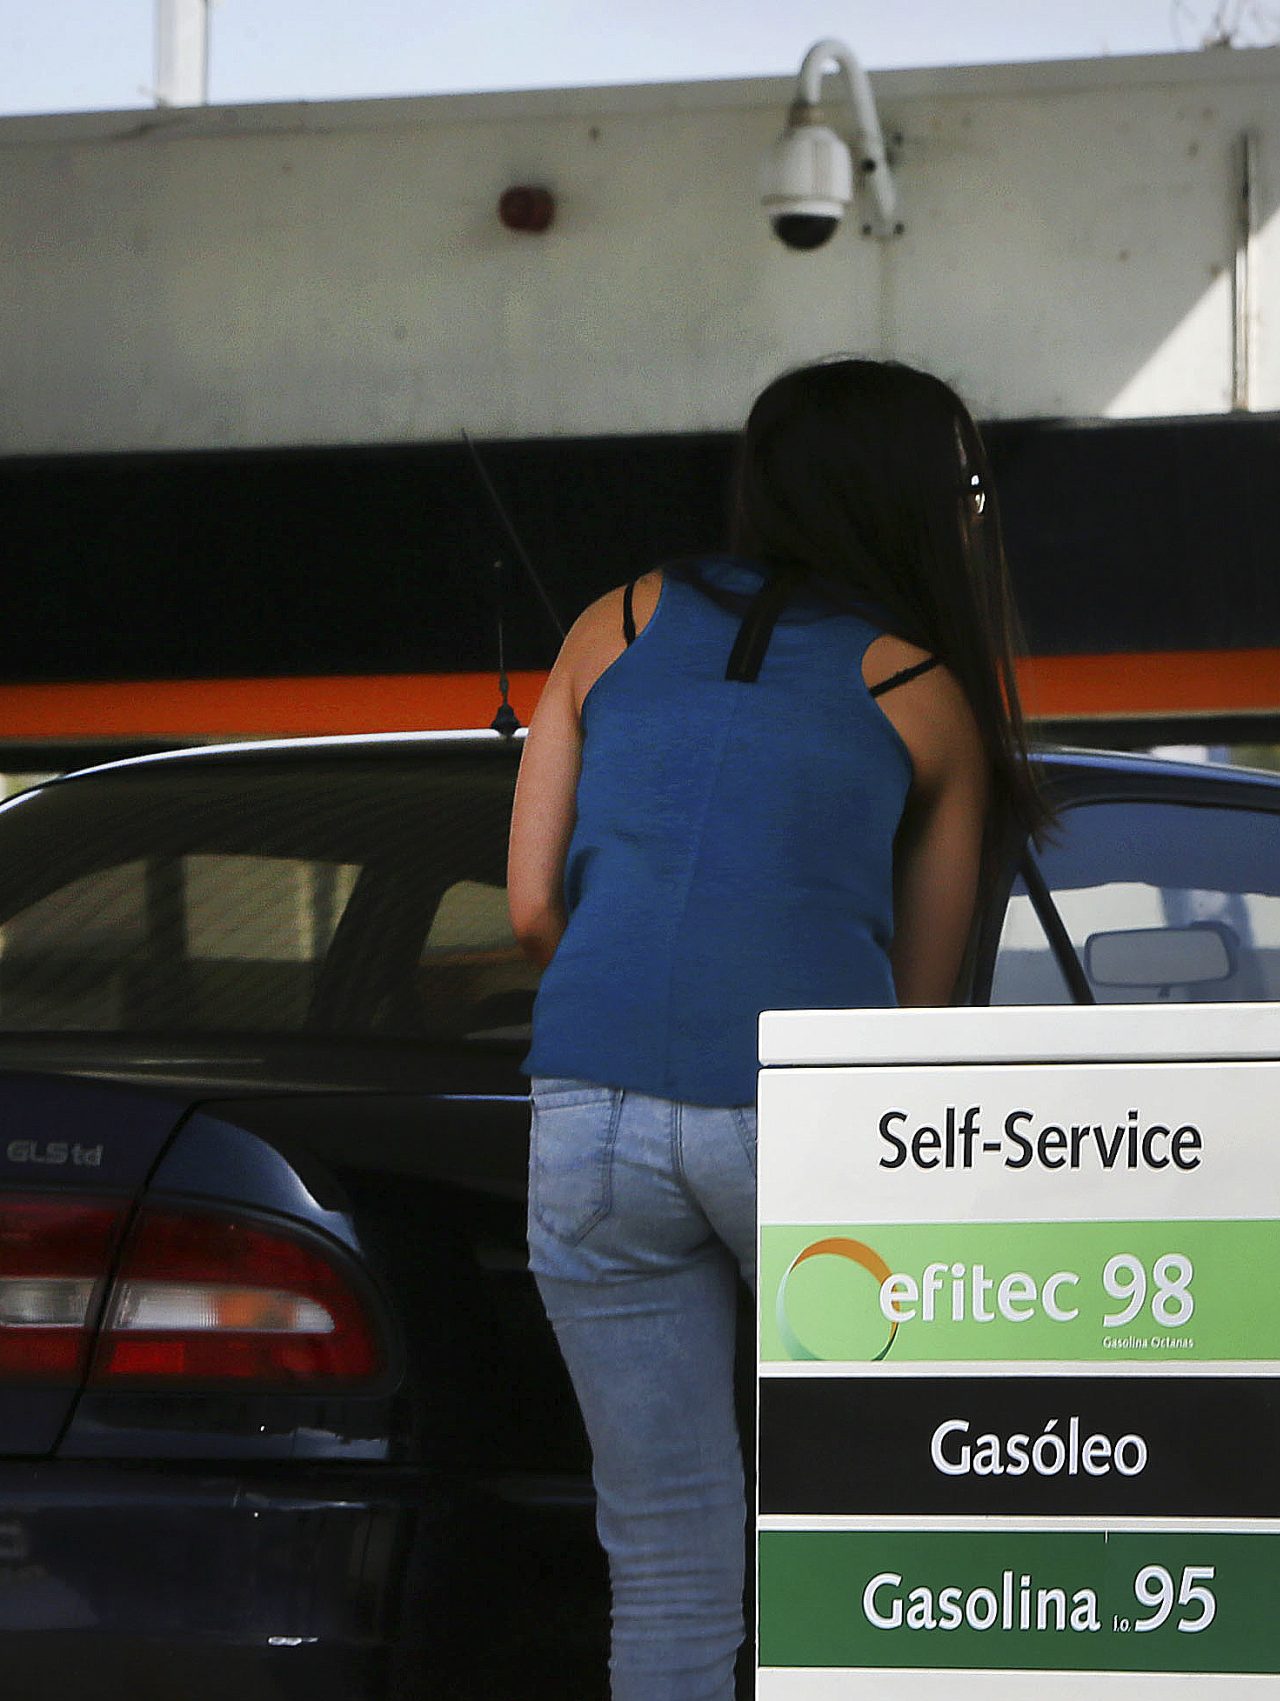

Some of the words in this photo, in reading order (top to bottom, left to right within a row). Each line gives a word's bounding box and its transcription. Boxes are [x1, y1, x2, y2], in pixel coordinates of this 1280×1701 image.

[878, 1107, 1202, 1169] Self-Service
[879, 1263, 1080, 1323] efitec
[1103, 1253, 1194, 1328] 98
[1103, 1335, 1148, 1349] Gasolina
[1151, 1336, 1195, 1349] Octanas
[930, 1416, 1148, 1476] Gasóleo
[863, 1570, 1101, 1632] Gasolina
[1134, 1565, 1216, 1633] 95
